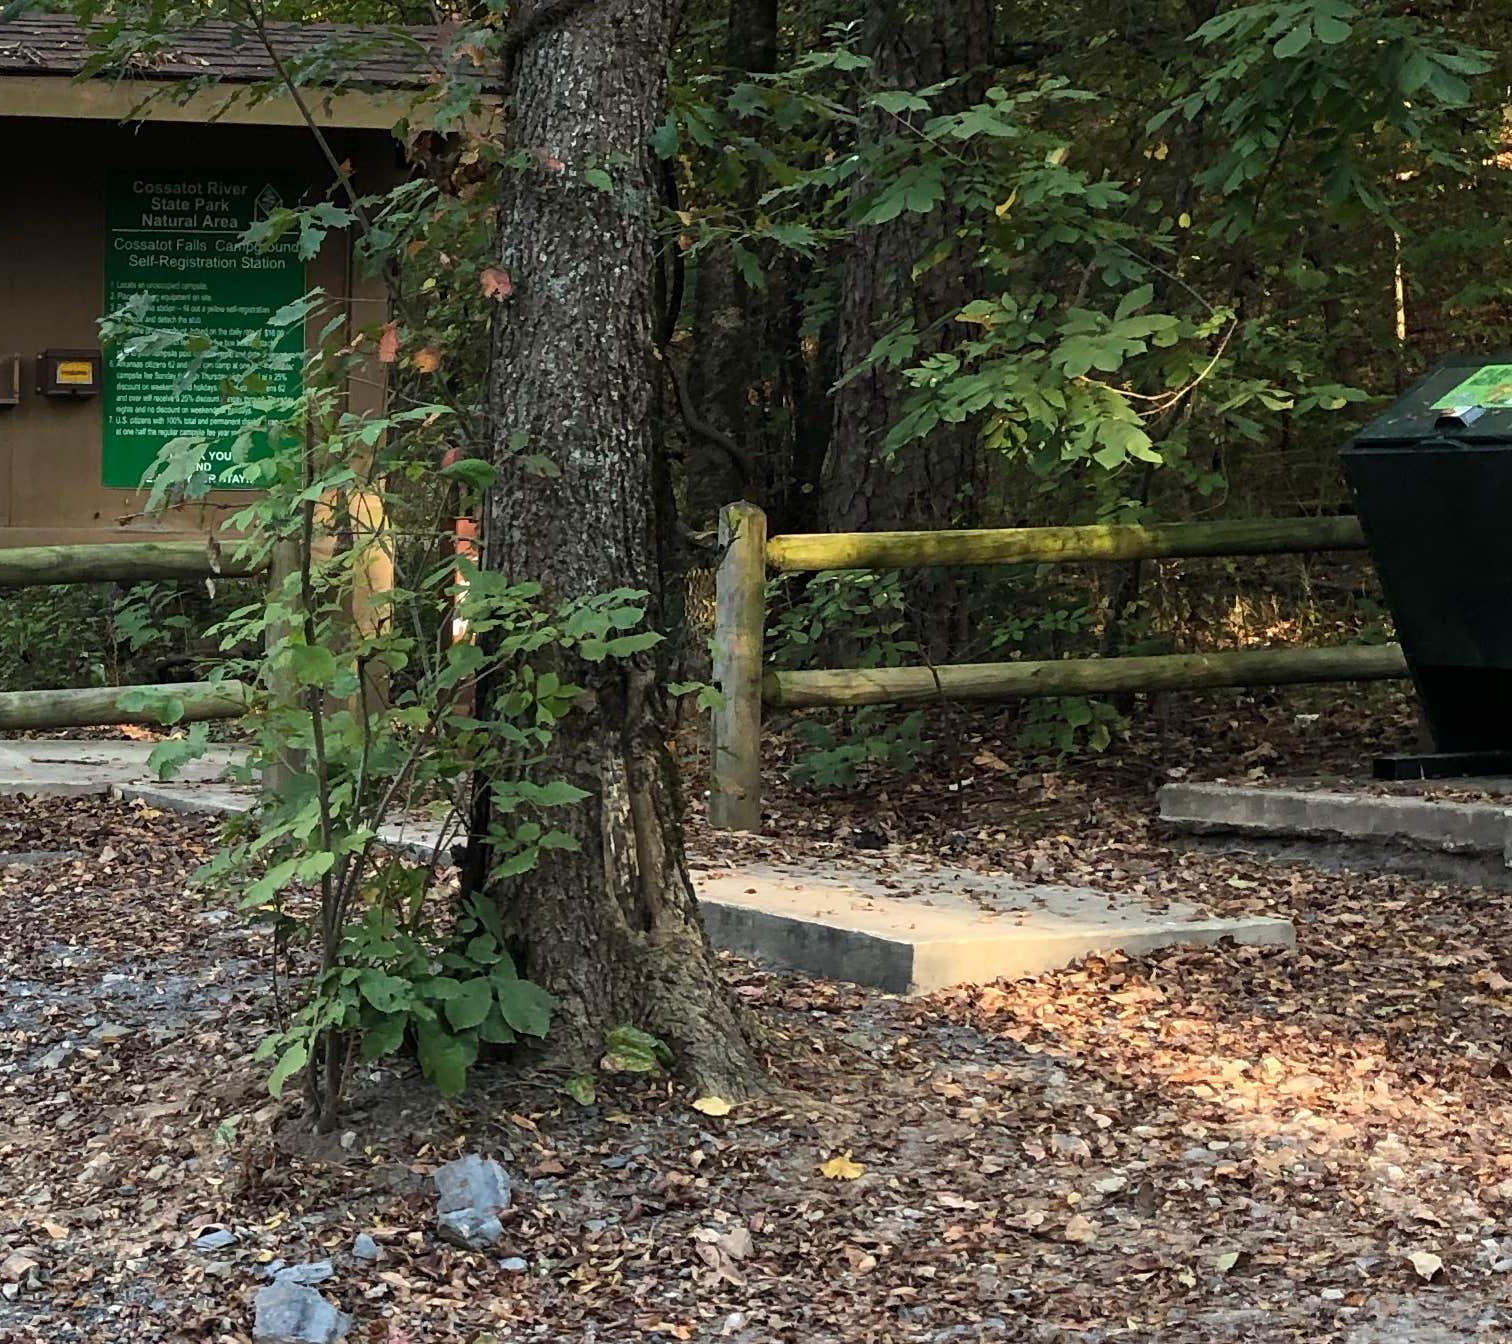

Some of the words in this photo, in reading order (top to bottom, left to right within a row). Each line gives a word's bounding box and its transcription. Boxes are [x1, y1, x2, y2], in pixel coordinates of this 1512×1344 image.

[132, 180, 203, 195] Cossatot
[207, 181, 248, 196] River
[151, 197, 190, 211] State
[195, 197, 230, 212] Park
[141, 213, 197, 228] Natural
[202, 215, 239, 229] Area
[114, 237, 173, 251] Cossatot
[176, 238, 208, 251] Falls
[215, 239, 300, 256] Campgound
[128, 254, 237, 271] Self-Registration
[241, 257, 286, 270] Station
[208, 451, 233, 461] YOU
[195, 462, 212, 472] ND
